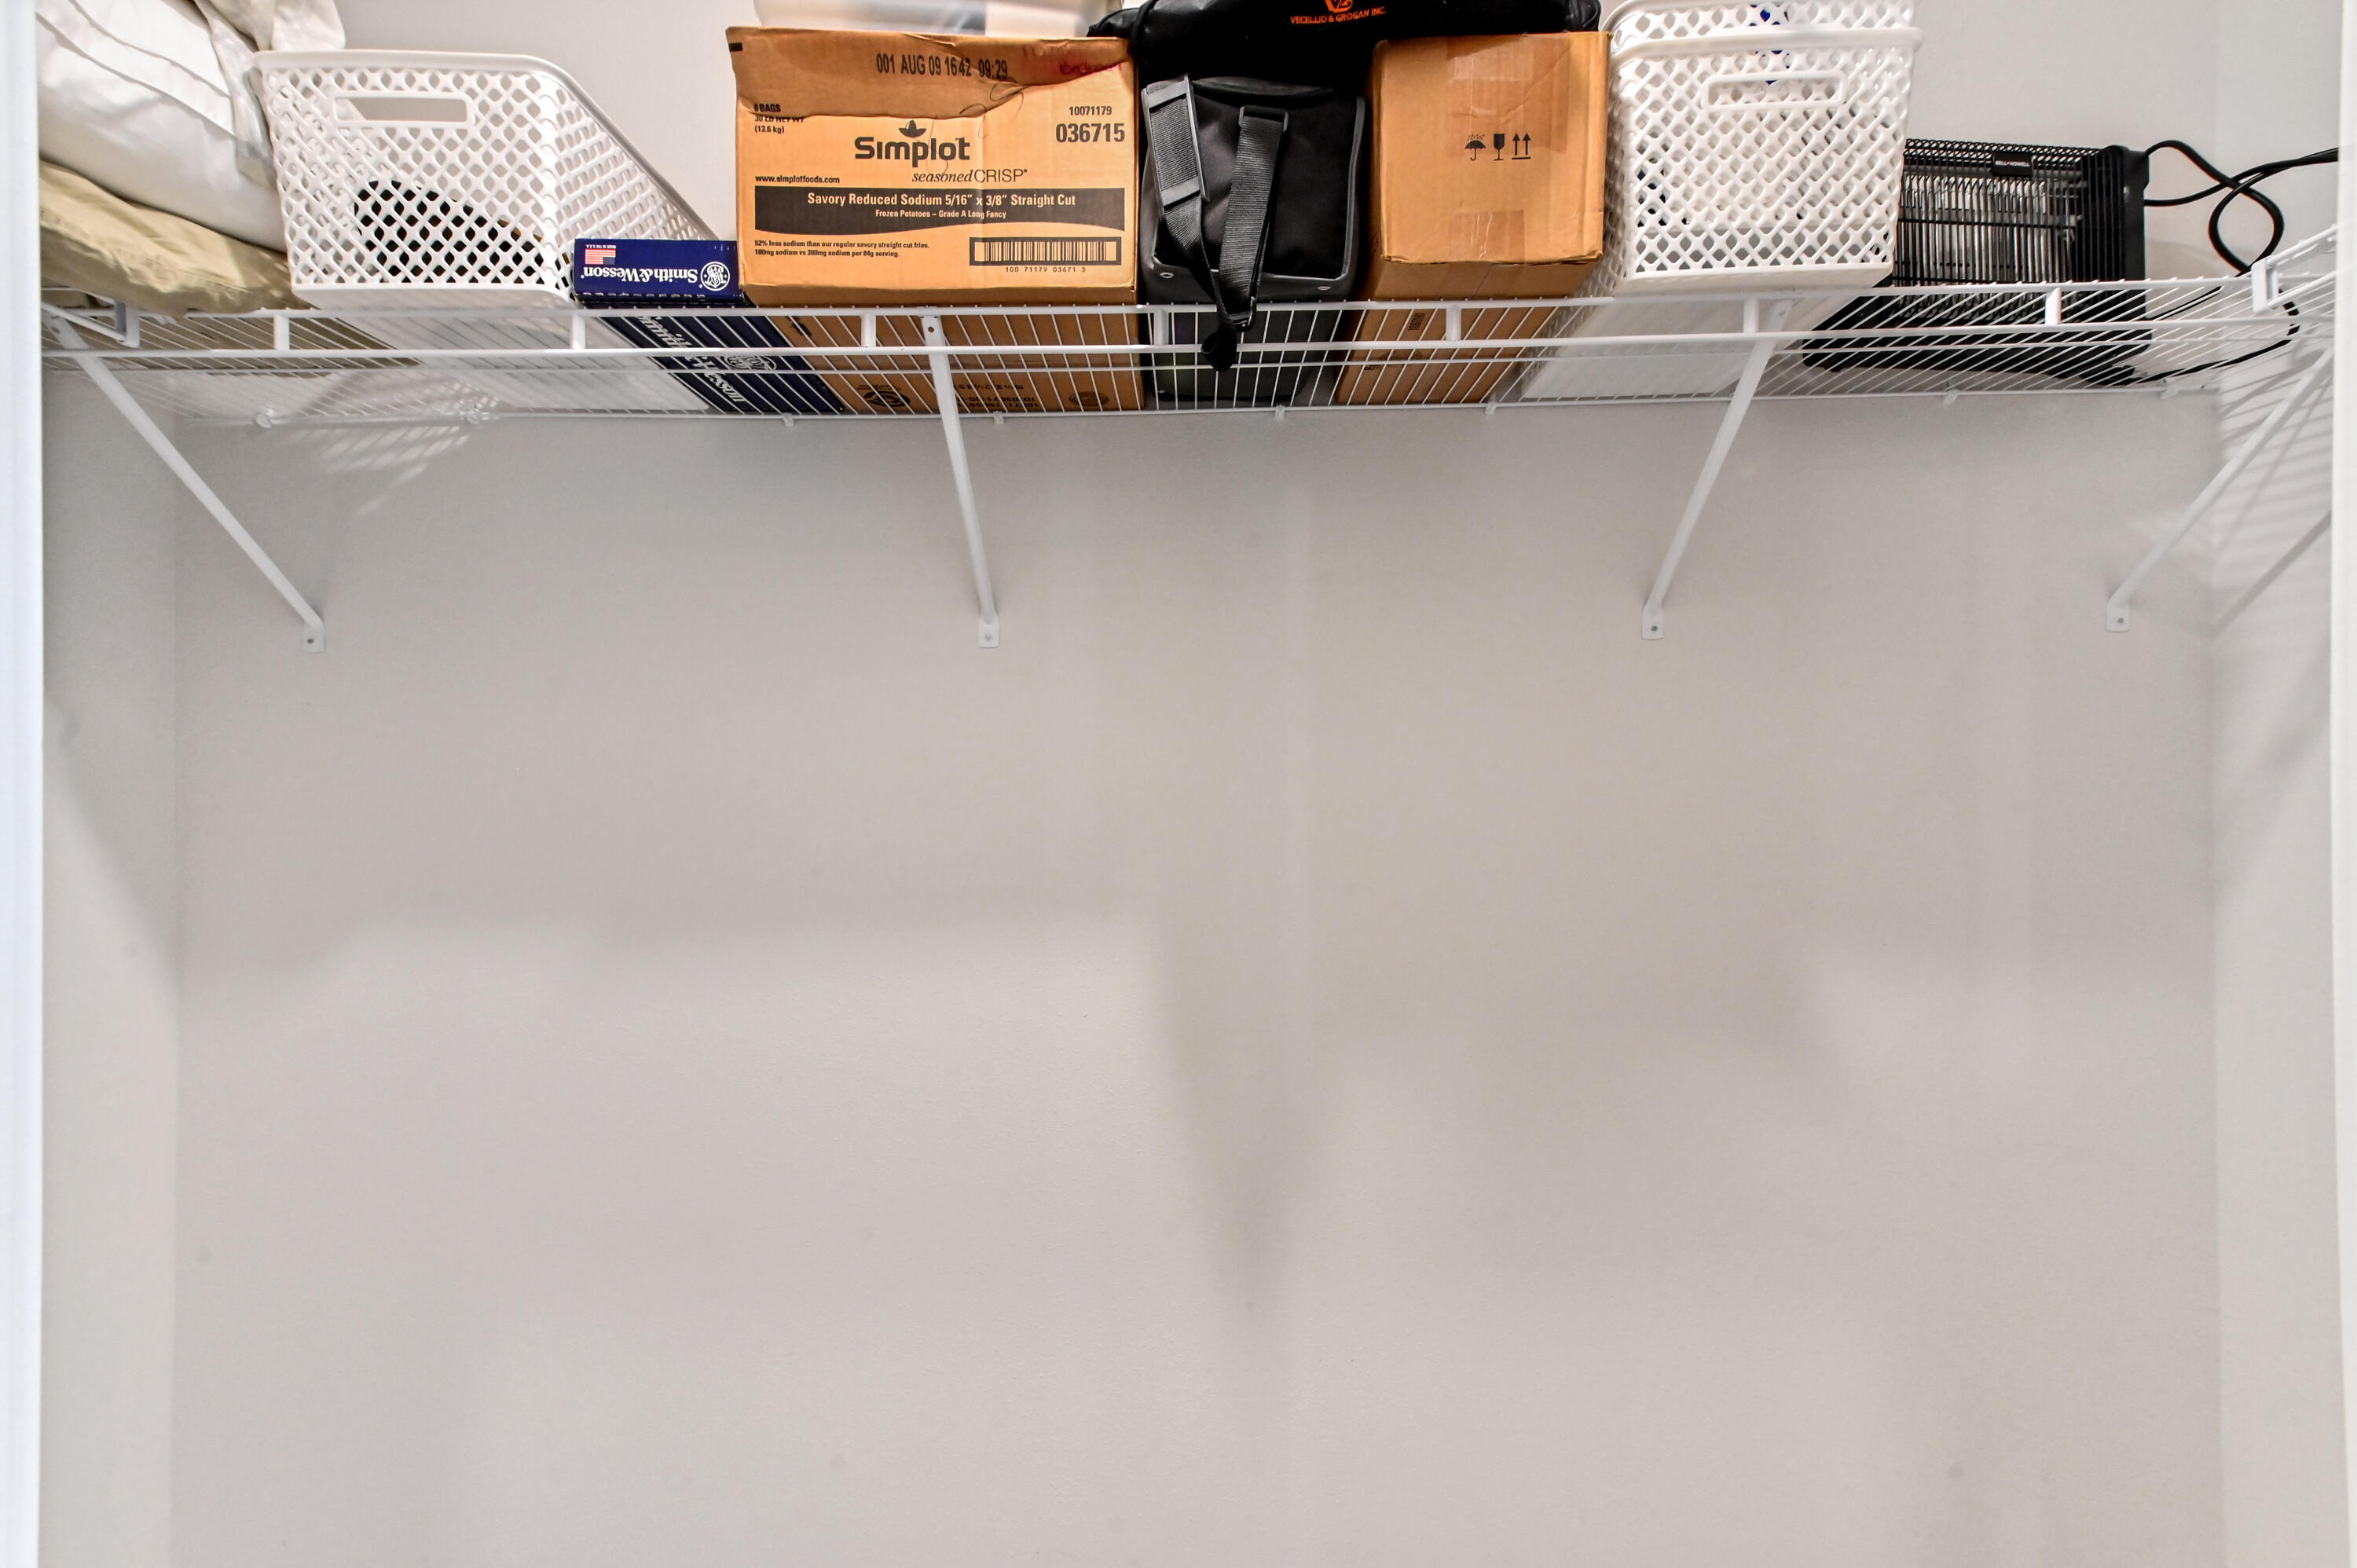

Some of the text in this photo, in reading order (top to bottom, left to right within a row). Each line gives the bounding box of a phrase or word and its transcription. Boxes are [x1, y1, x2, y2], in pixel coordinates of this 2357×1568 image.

[1336, 9, 1369, 22] GROGAN
[876, 53, 896, 74] 001
[900, 54, 926, 75] AUG
[929, 56, 941, 76] 09
[978, 58, 1008, 79] 09:29
[759, 103, 781, 112] BAGS
[1069, 106, 1113, 115] 10071179
[755, 125, 784, 134] (13.6 kg)
[1056, 123, 1125, 143] 036715
[854, 137, 970, 168] Simplot
[755, 175, 840, 184] www.simplotfoods.com
[808, 192, 845, 207] Savory
[849, 193, 897, 205] Reduced
[900, 194, 942, 206] Sodium
[976, 197, 983, 206] x
[1010, 194, 1054, 208] Straight
[1058, 194, 1076, 206] Cut
[968, 211, 984, 219] Long
[878, 241, 902, 250] straight
